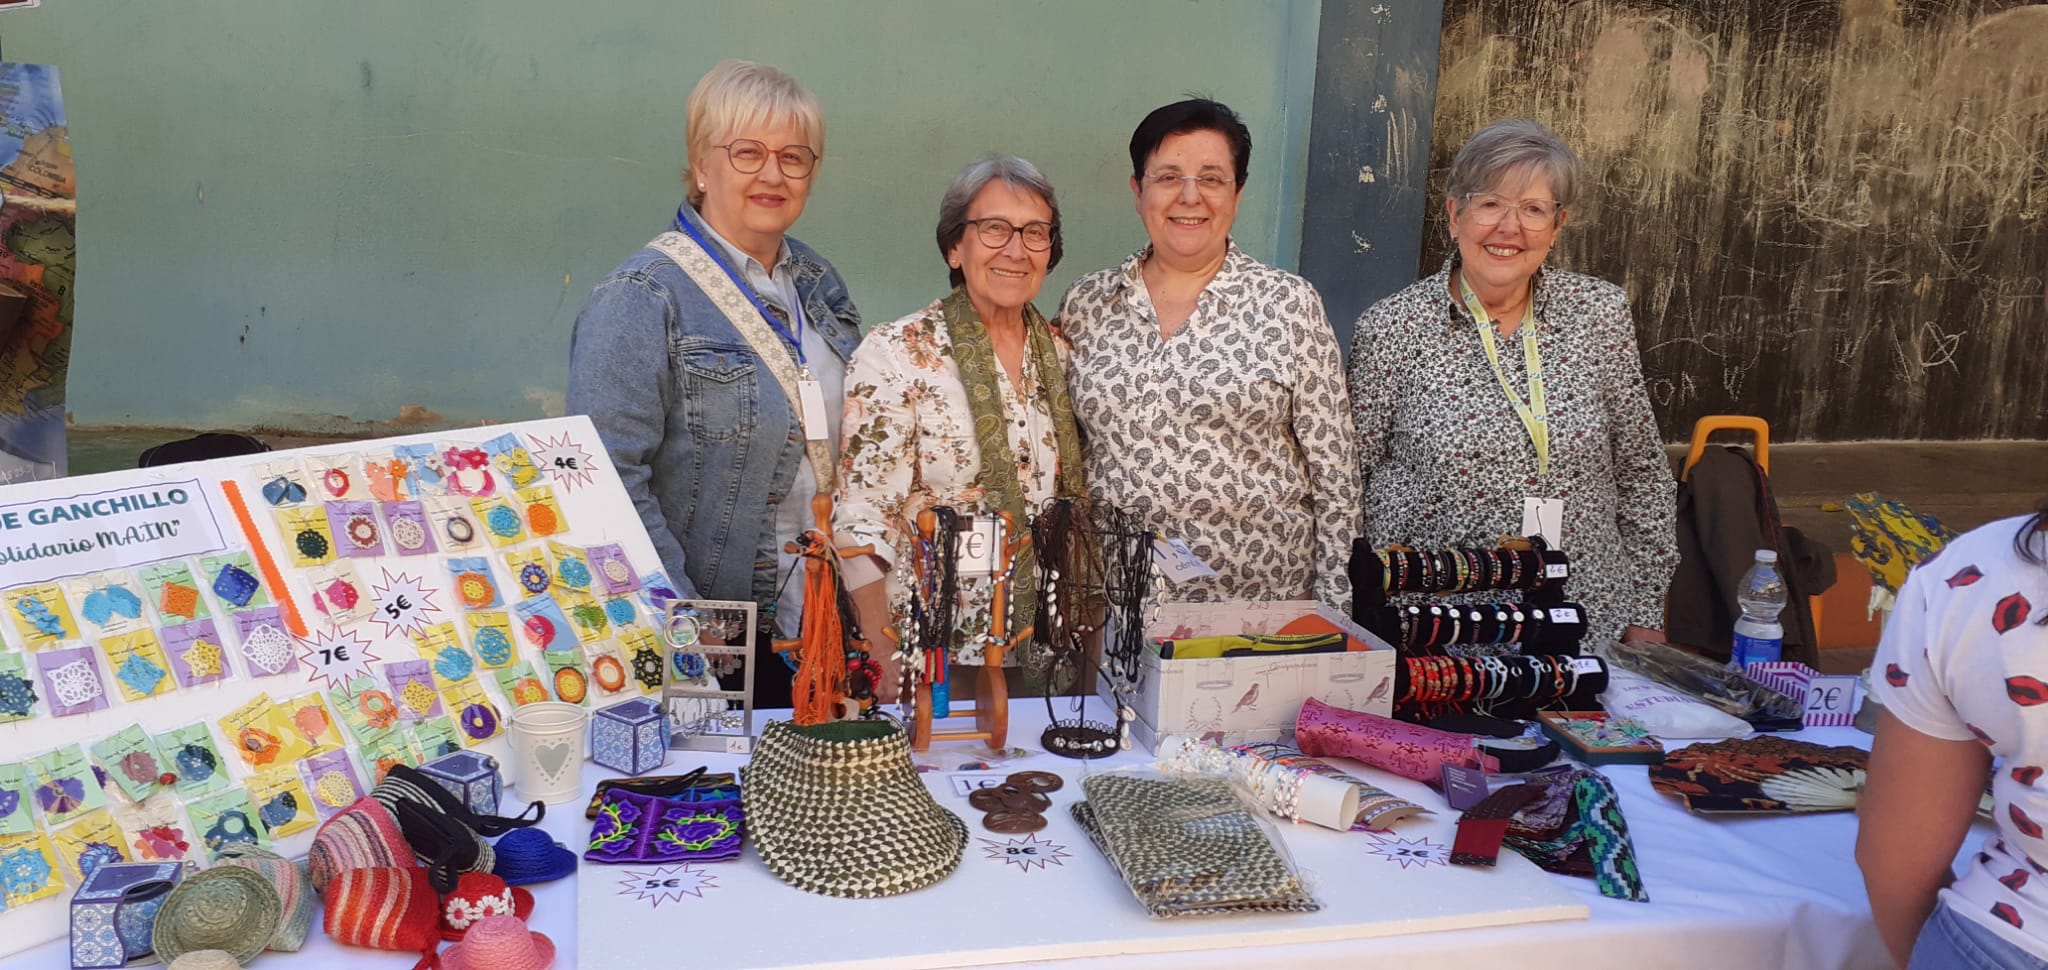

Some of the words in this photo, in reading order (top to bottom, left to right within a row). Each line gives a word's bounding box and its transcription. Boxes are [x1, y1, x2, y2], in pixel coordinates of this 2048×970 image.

[554, 456, 578, 470] 4€
[0, 511, 22, 530] E
[28, 488, 189, 526] GANCHILLO
[385, 594, 412, 619] 5€
[319, 645, 350, 665] 7€
[1808, 686, 1841, 710] 2€
[1006, 847, 1038, 855] 8€
[1397, 848, 1429, 857] 2€
[645, 878, 681, 889] 5€
